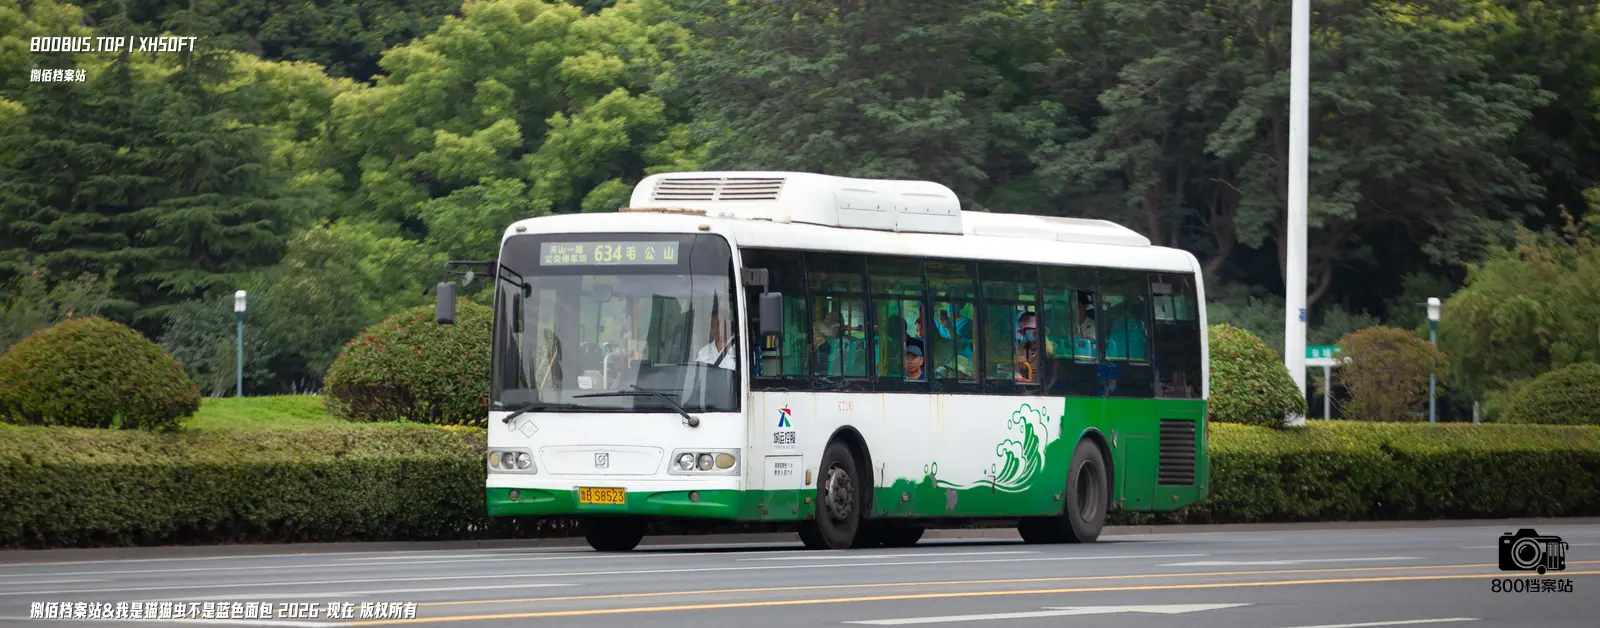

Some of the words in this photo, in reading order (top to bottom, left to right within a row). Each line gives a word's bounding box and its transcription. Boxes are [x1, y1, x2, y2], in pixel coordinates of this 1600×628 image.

[594, 244, 622, 262] 634
[626, 246, 674, 260] 毛公山
[595, 490, 624, 502] S8523
